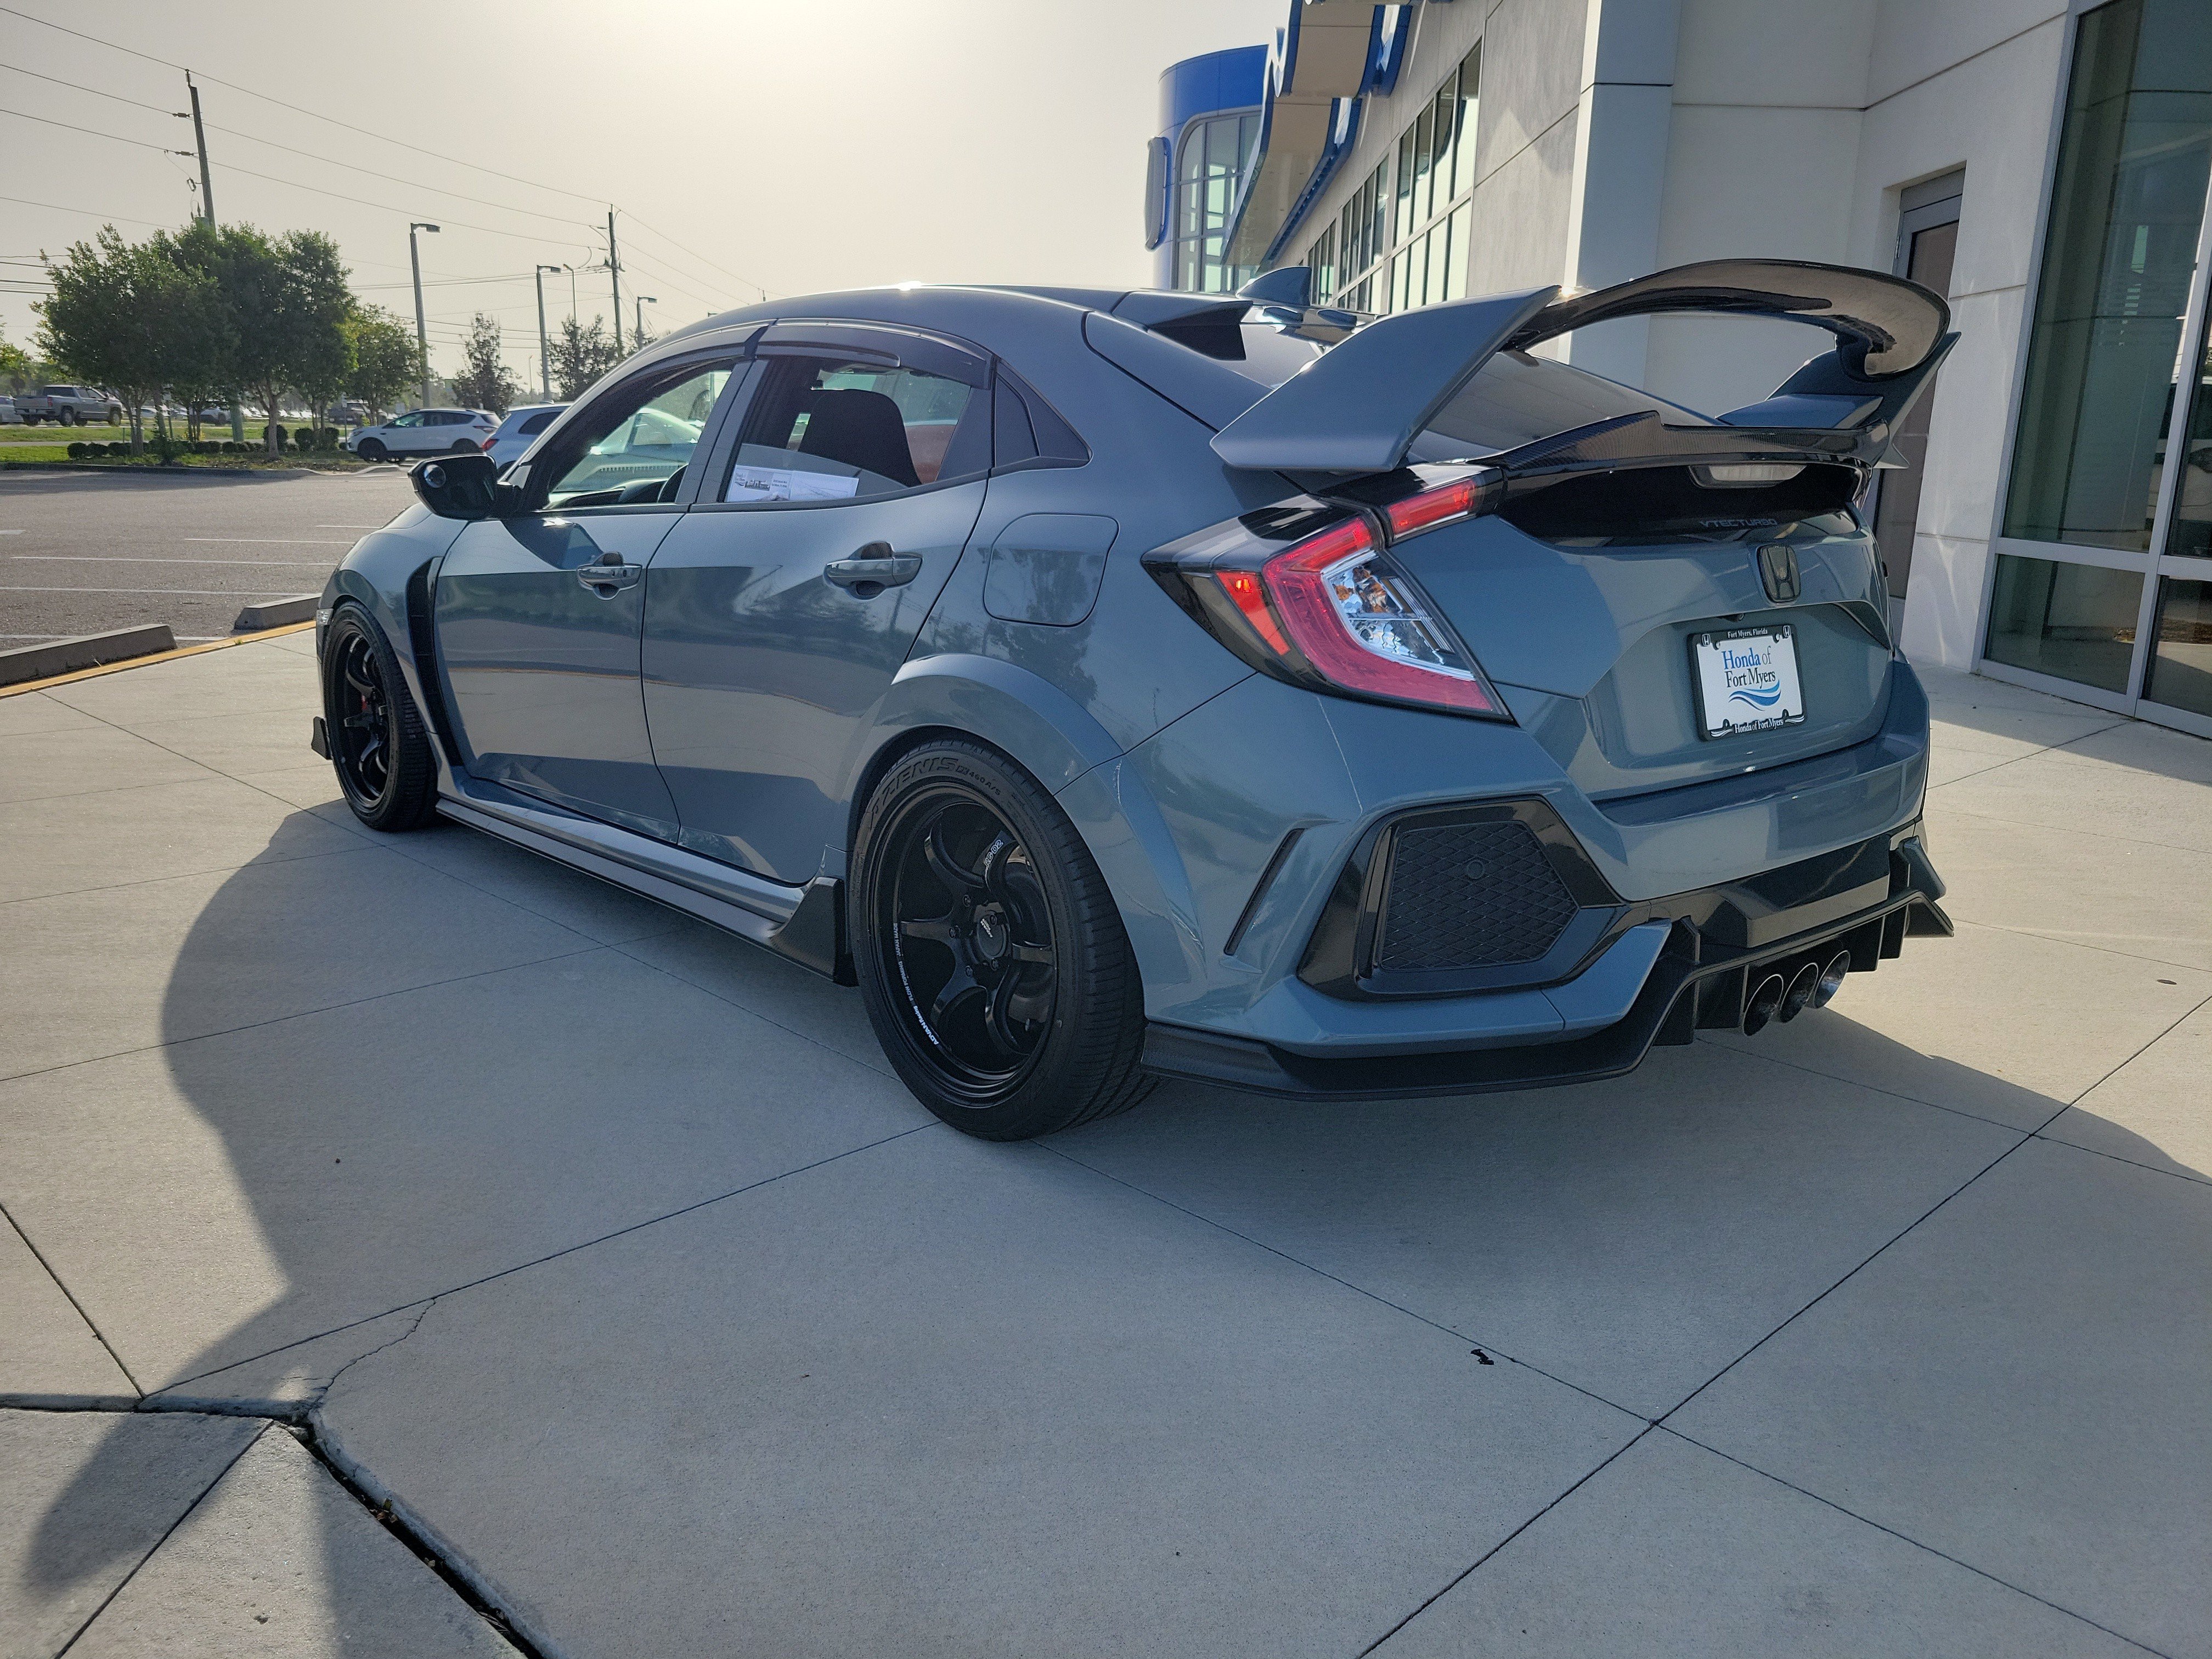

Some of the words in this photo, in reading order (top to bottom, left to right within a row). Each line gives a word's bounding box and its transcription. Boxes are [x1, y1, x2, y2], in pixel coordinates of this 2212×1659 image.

[1752, 628, 1768, 636] Florida
[1721, 647, 1762, 670] Honda
[1762, 646, 1772, 665] of
[1724, 670, 1747, 688] Fort
[1747, 667, 1776, 689] Myers
[1734, 722, 1752, 733] Honda
[1752, 723, 1757, 731] of
[1758, 720, 1768, 730] Fort
[1768, 718, 1784, 730] Myers
[905, 986, 914, 1002] FLOW
[913, 1006, 924, 1023] Racing
[921, 1022, 939, 1045] ADVAN
